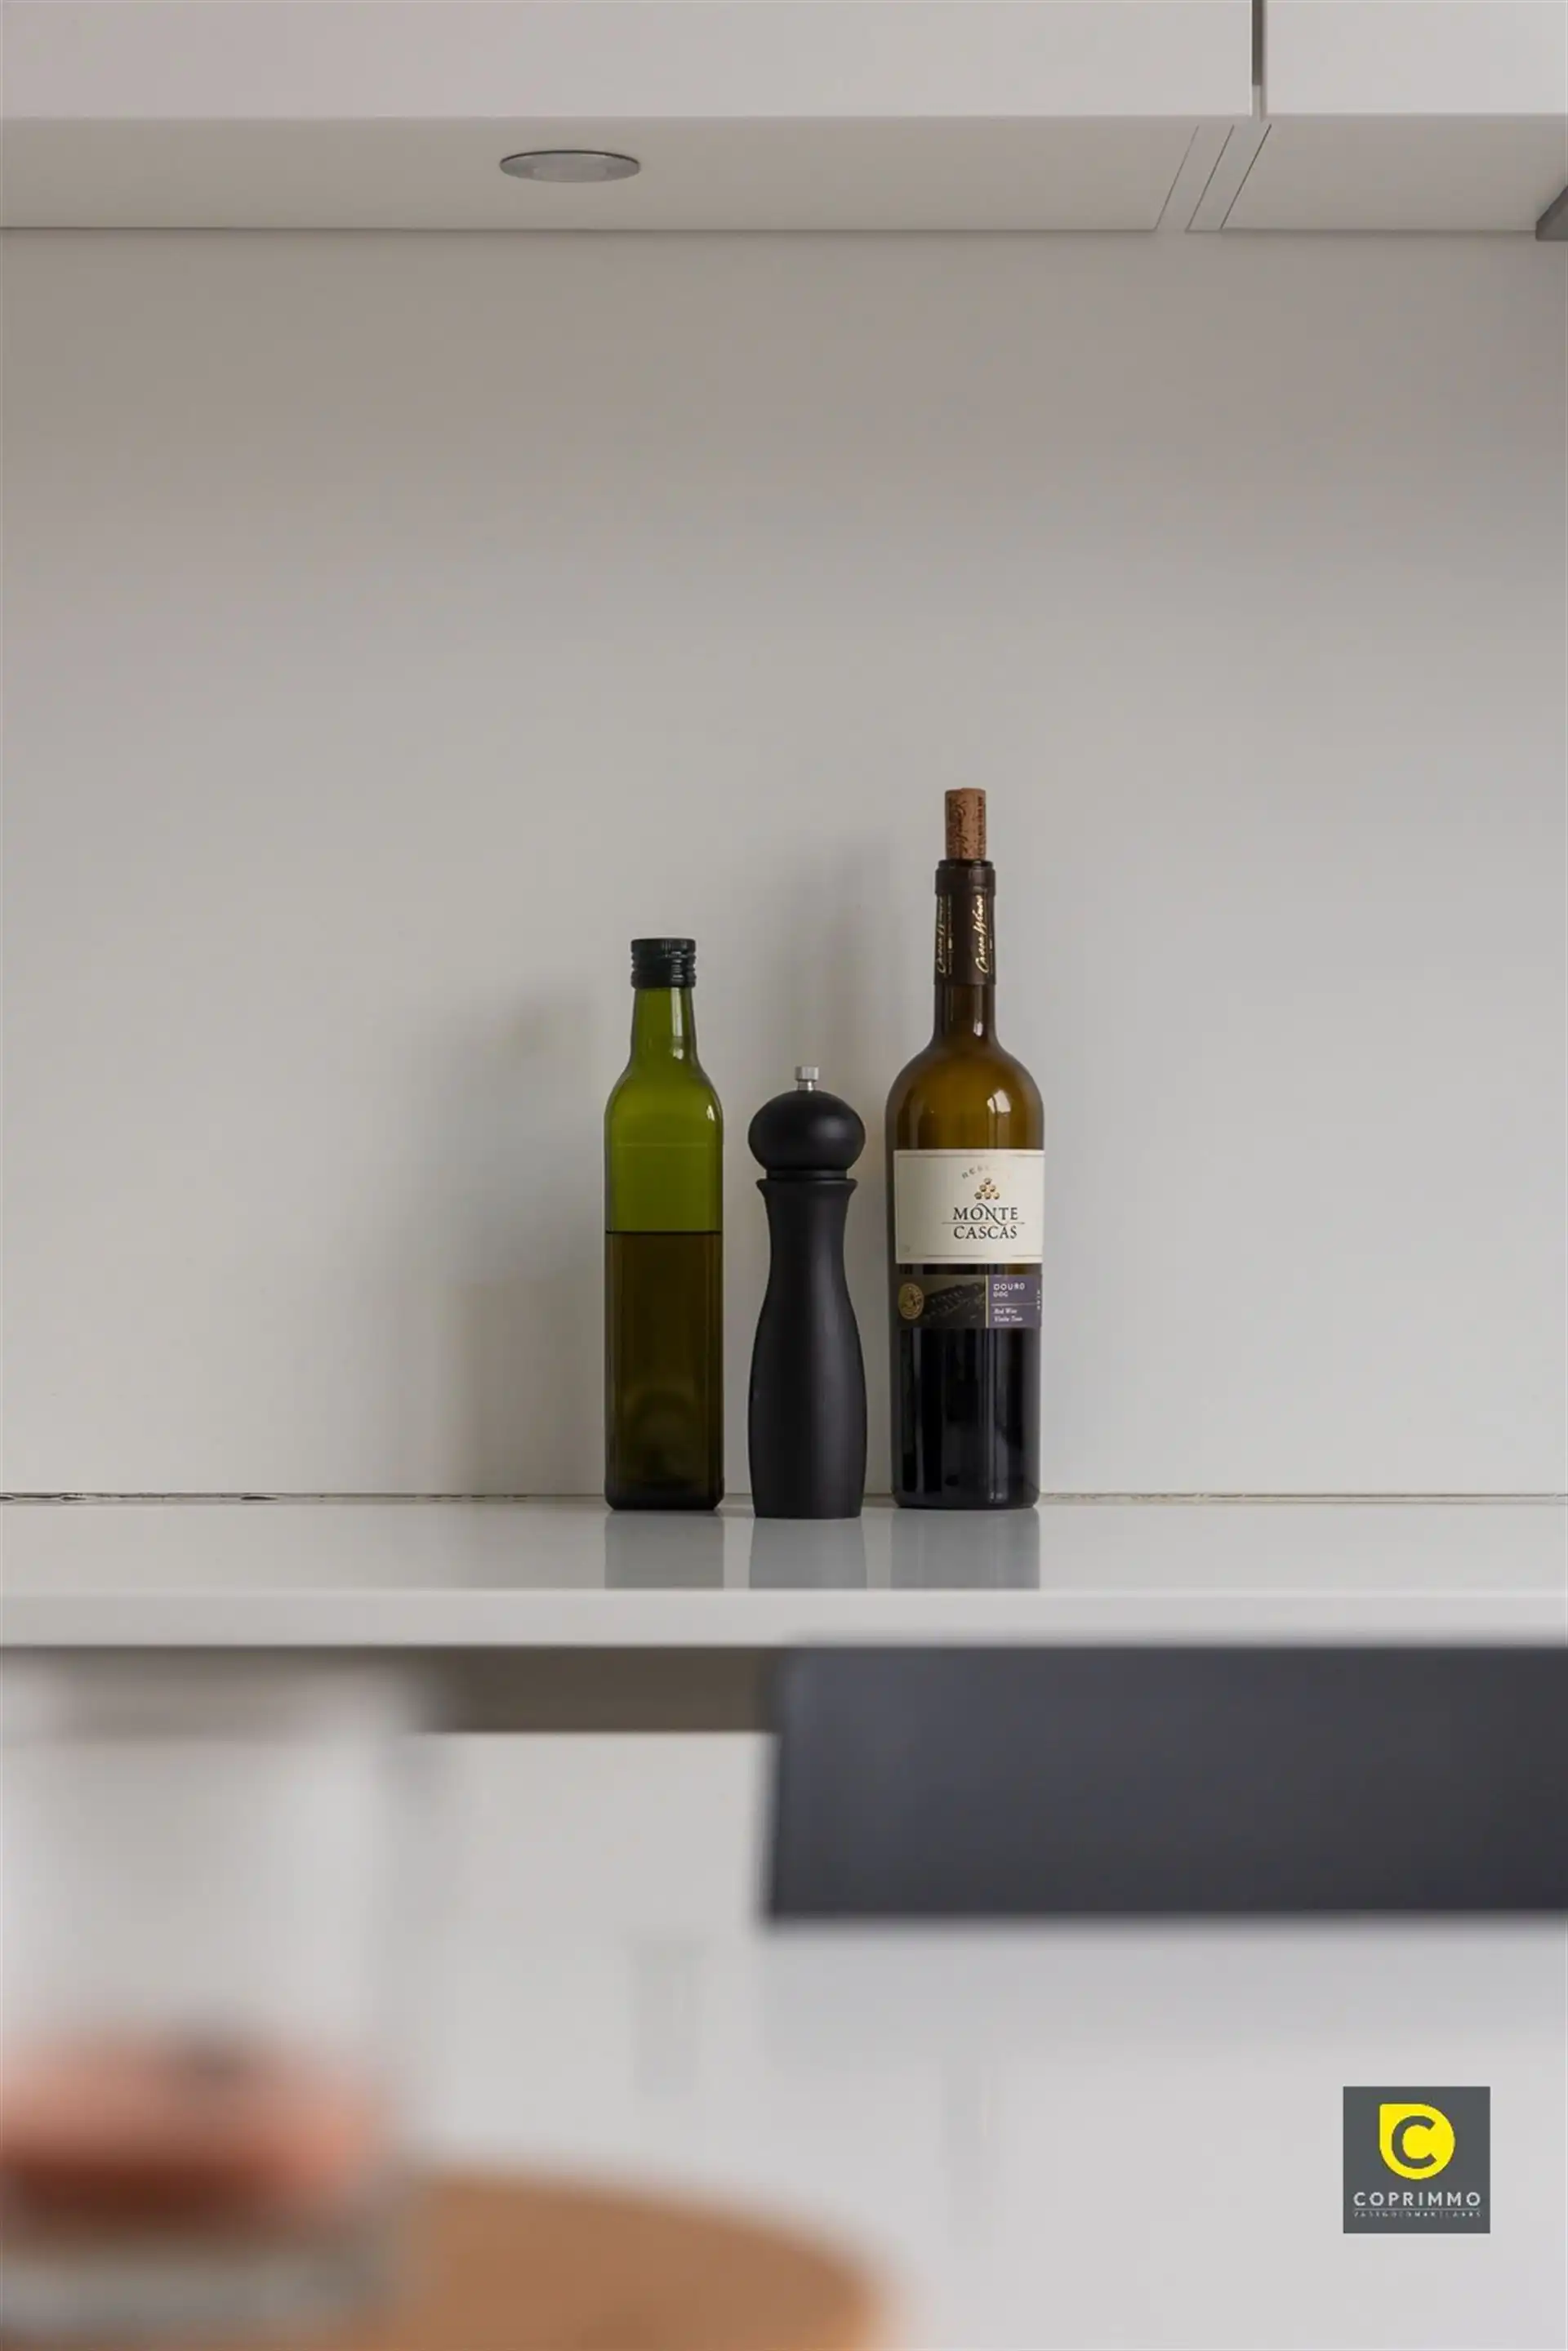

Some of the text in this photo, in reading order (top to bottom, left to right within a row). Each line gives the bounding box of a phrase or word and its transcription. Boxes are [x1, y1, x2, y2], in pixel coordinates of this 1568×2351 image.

[952, 1203, 1018, 1224] MONTE
[953, 1225, 1018, 1240] CASCAS
[993, 1282, 1025, 1290] DOURO
